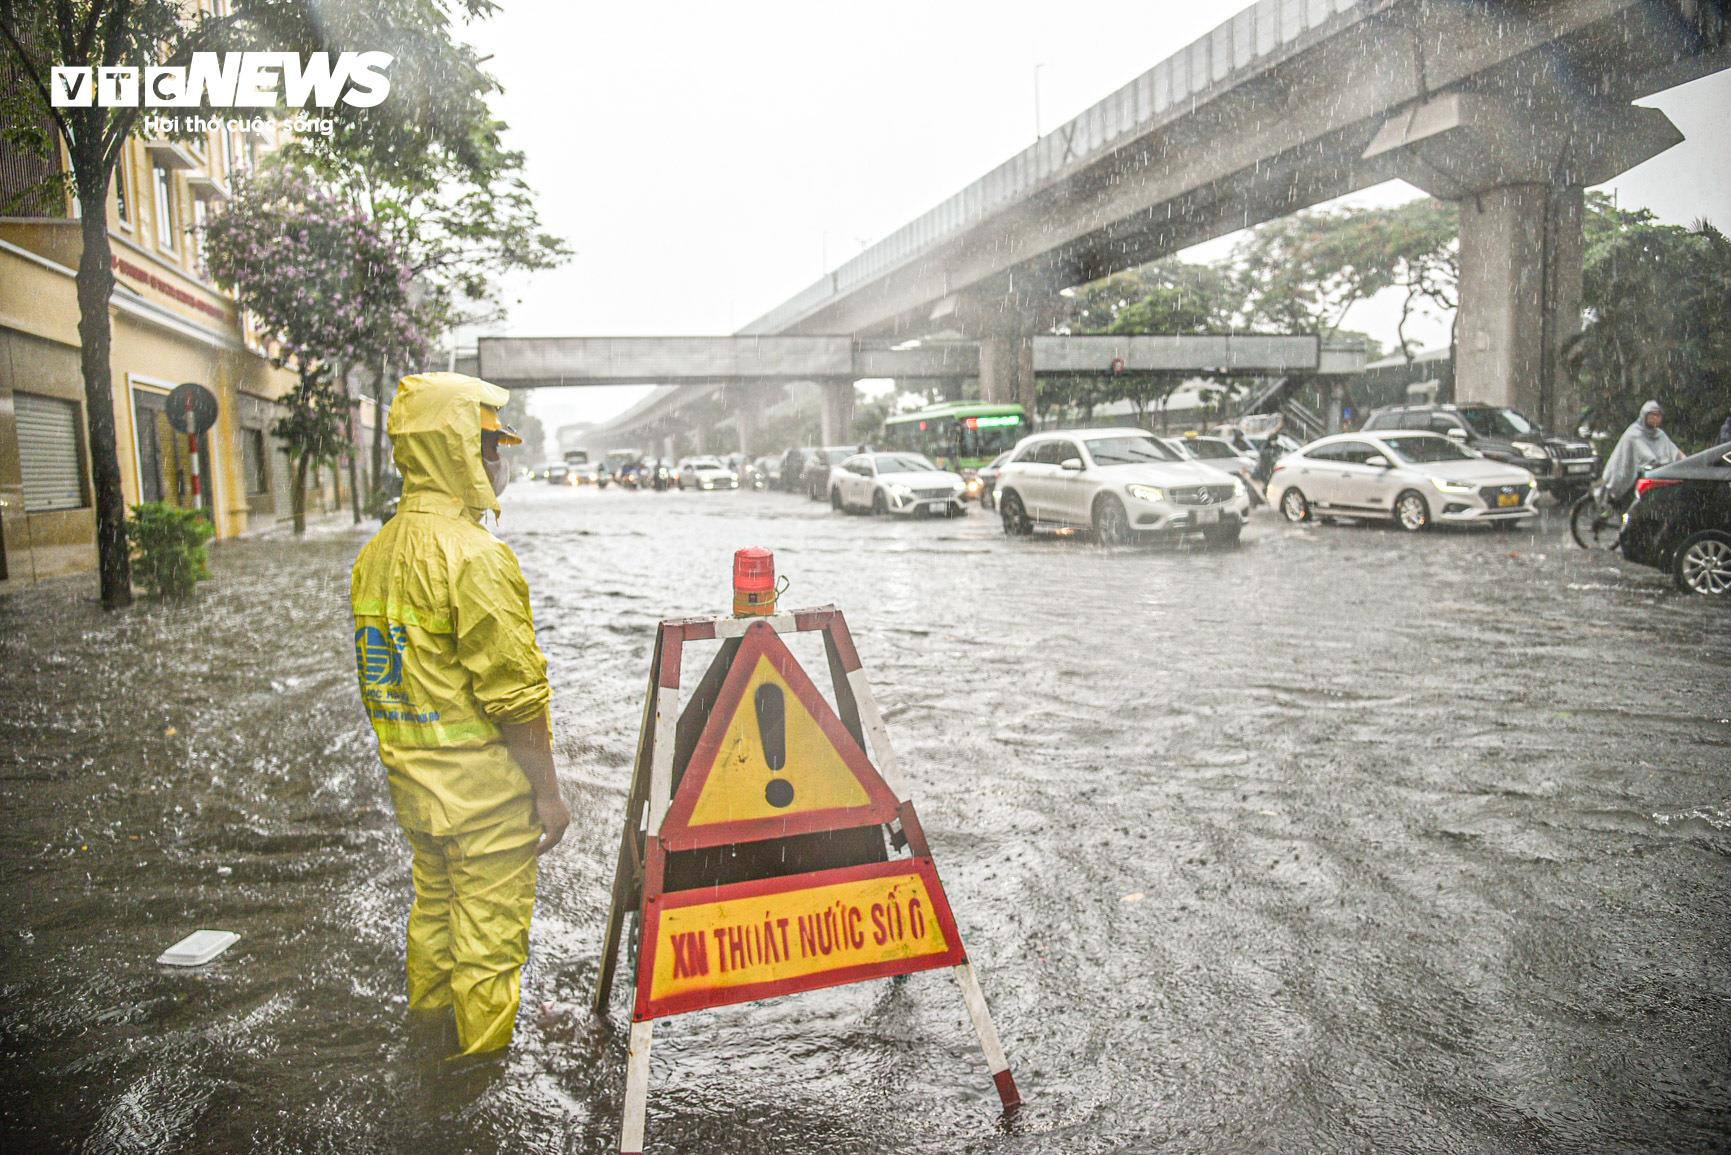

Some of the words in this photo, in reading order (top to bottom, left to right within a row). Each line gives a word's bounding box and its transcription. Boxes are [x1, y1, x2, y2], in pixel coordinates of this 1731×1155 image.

[670, 930, 709, 980] XN
[713, 910, 790, 973] THOÁT
[797, 900, 865, 959] NƯỚC
[870, 885, 904, 946] SỐ
